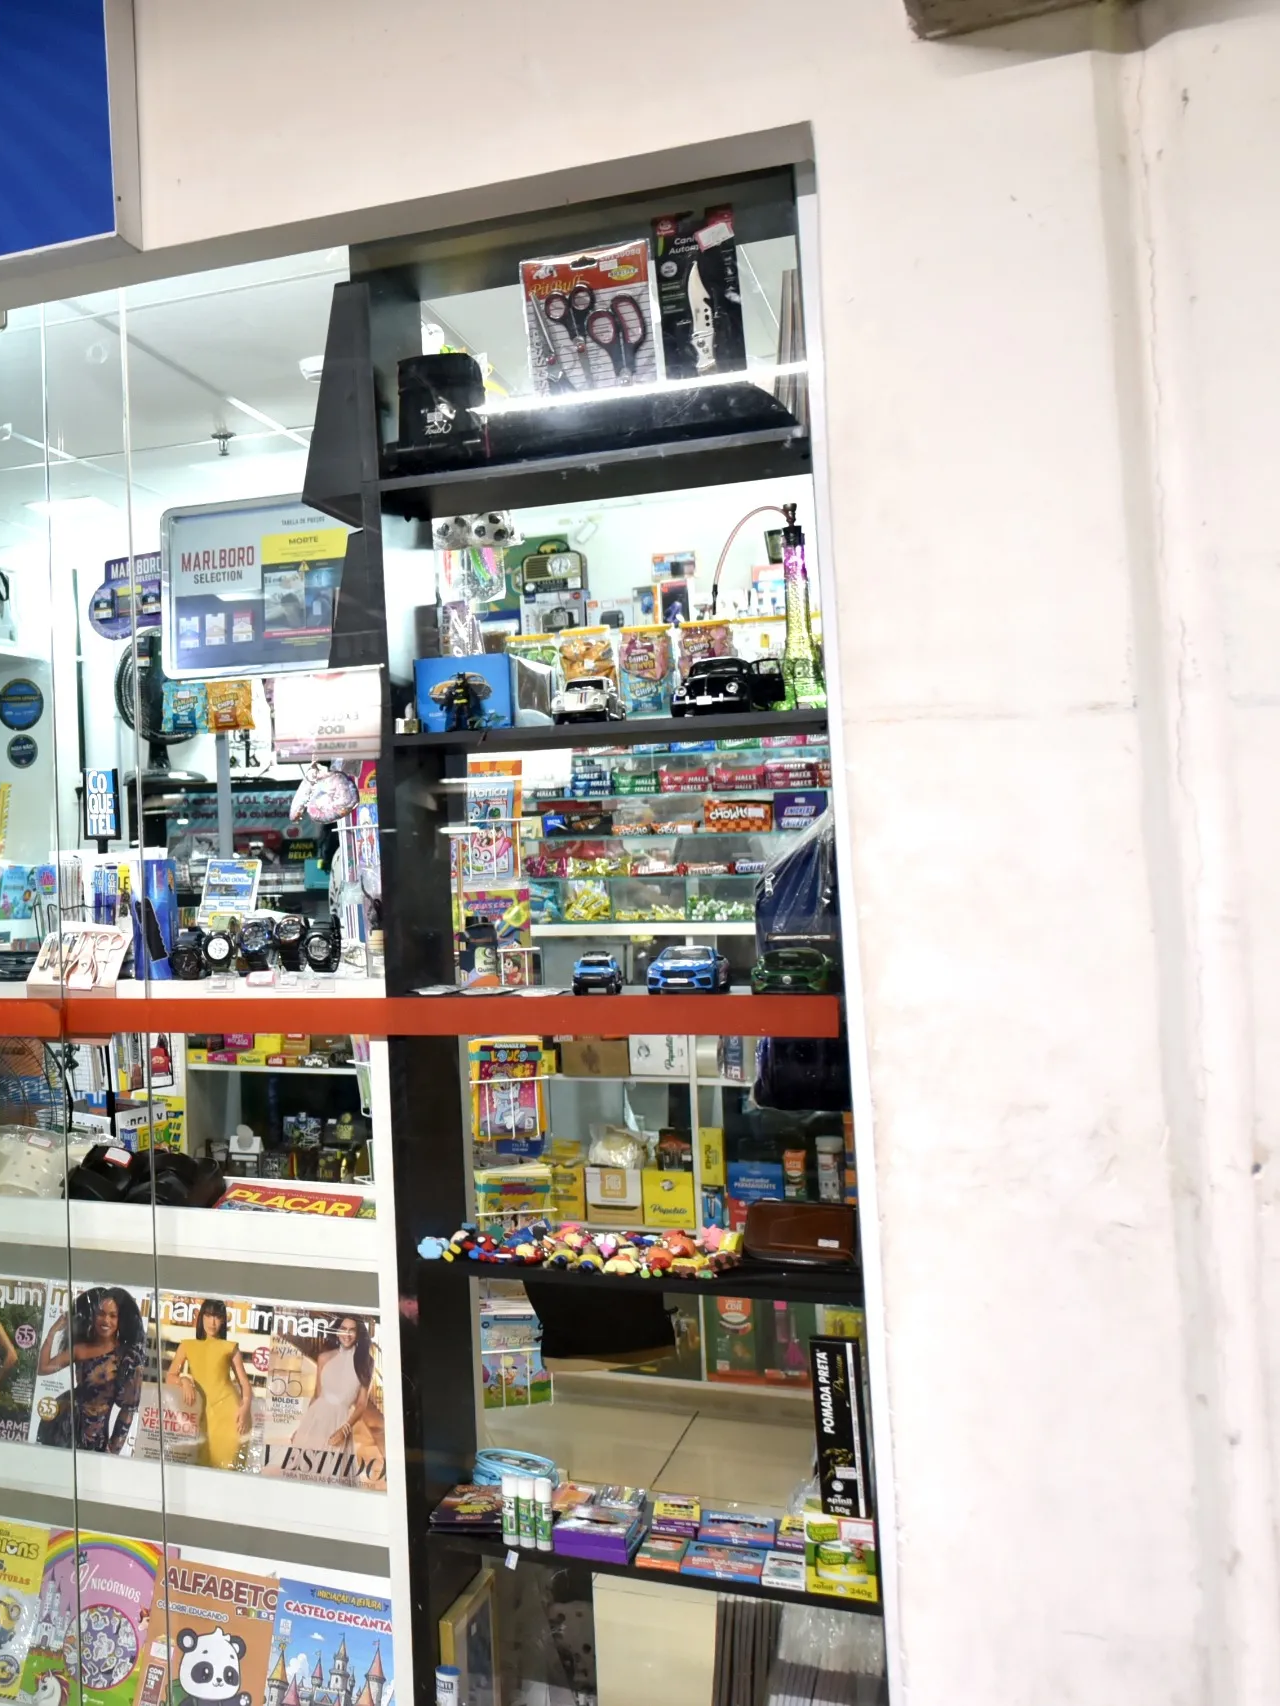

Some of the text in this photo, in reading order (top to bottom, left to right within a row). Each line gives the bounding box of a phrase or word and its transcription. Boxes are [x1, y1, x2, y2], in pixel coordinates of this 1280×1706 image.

[288, 536, 319, 546] MORTE
[181, 545, 255, 573] MARLBORO
[194, 569, 243, 585] SELECTION
[88, 770, 108, 795] CO
[578, 772, 600, 780] HALLS
[590, 779, 611, 787] HALLS
[635, 777, 657, 786] HALLS
[688, 775, 710, 783] HALLS
[735, 774, 758, 782] HALLS
[589, 789, 610, 797] HALLS
[88, 793, 114, 815] QUE
[784, 805, 816, 816] SNICKERS
[89, 814, 115, 835] TEL
[225, 1188, 353, 1218] PLACAR
[17, 1327, 34, 1342] 55
[270, 1369, 303, 1398] 55
[819, 1350, 836, 1435] POMADA PRETA
[39, 1400, 59, 1415] 55
[272, 1396, 300, 1405] MOLDES
[161, 1566, 279, 1611] ALFABETO
[157, 1600, 230, 1623] COLORIR EDUCANDO
[284, 1599, 393, 1634] CASTELO ENCANTA
